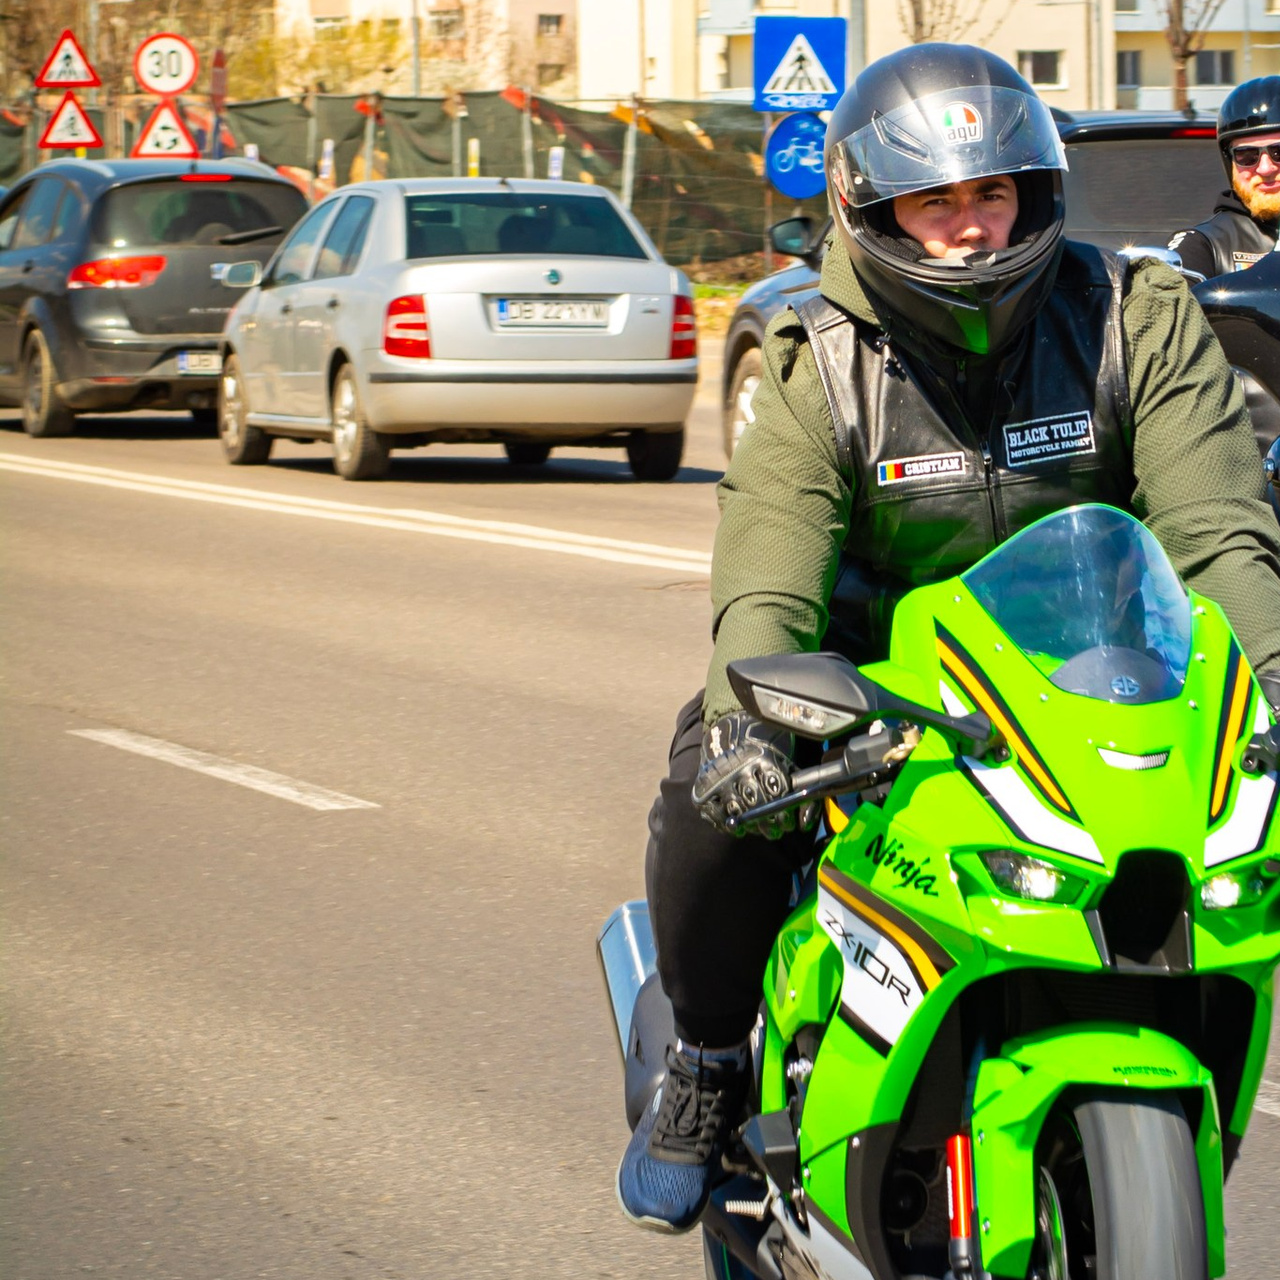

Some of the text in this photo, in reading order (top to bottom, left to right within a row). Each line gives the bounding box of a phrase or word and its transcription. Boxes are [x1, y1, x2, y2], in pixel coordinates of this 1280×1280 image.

[147, 50, 182, 78] 30
[947, 124, 977, 141] agv
[1008, 419, 1088, 448] BLACK TULIP
[1010, 436, 1091, 459] MOTORCYCLE FAMILY
[904, 457, 960, 476] CRISTIAN
[865, 832, 939, 897] Ninja
[825, 909, 911, 1008] ZX-10R
